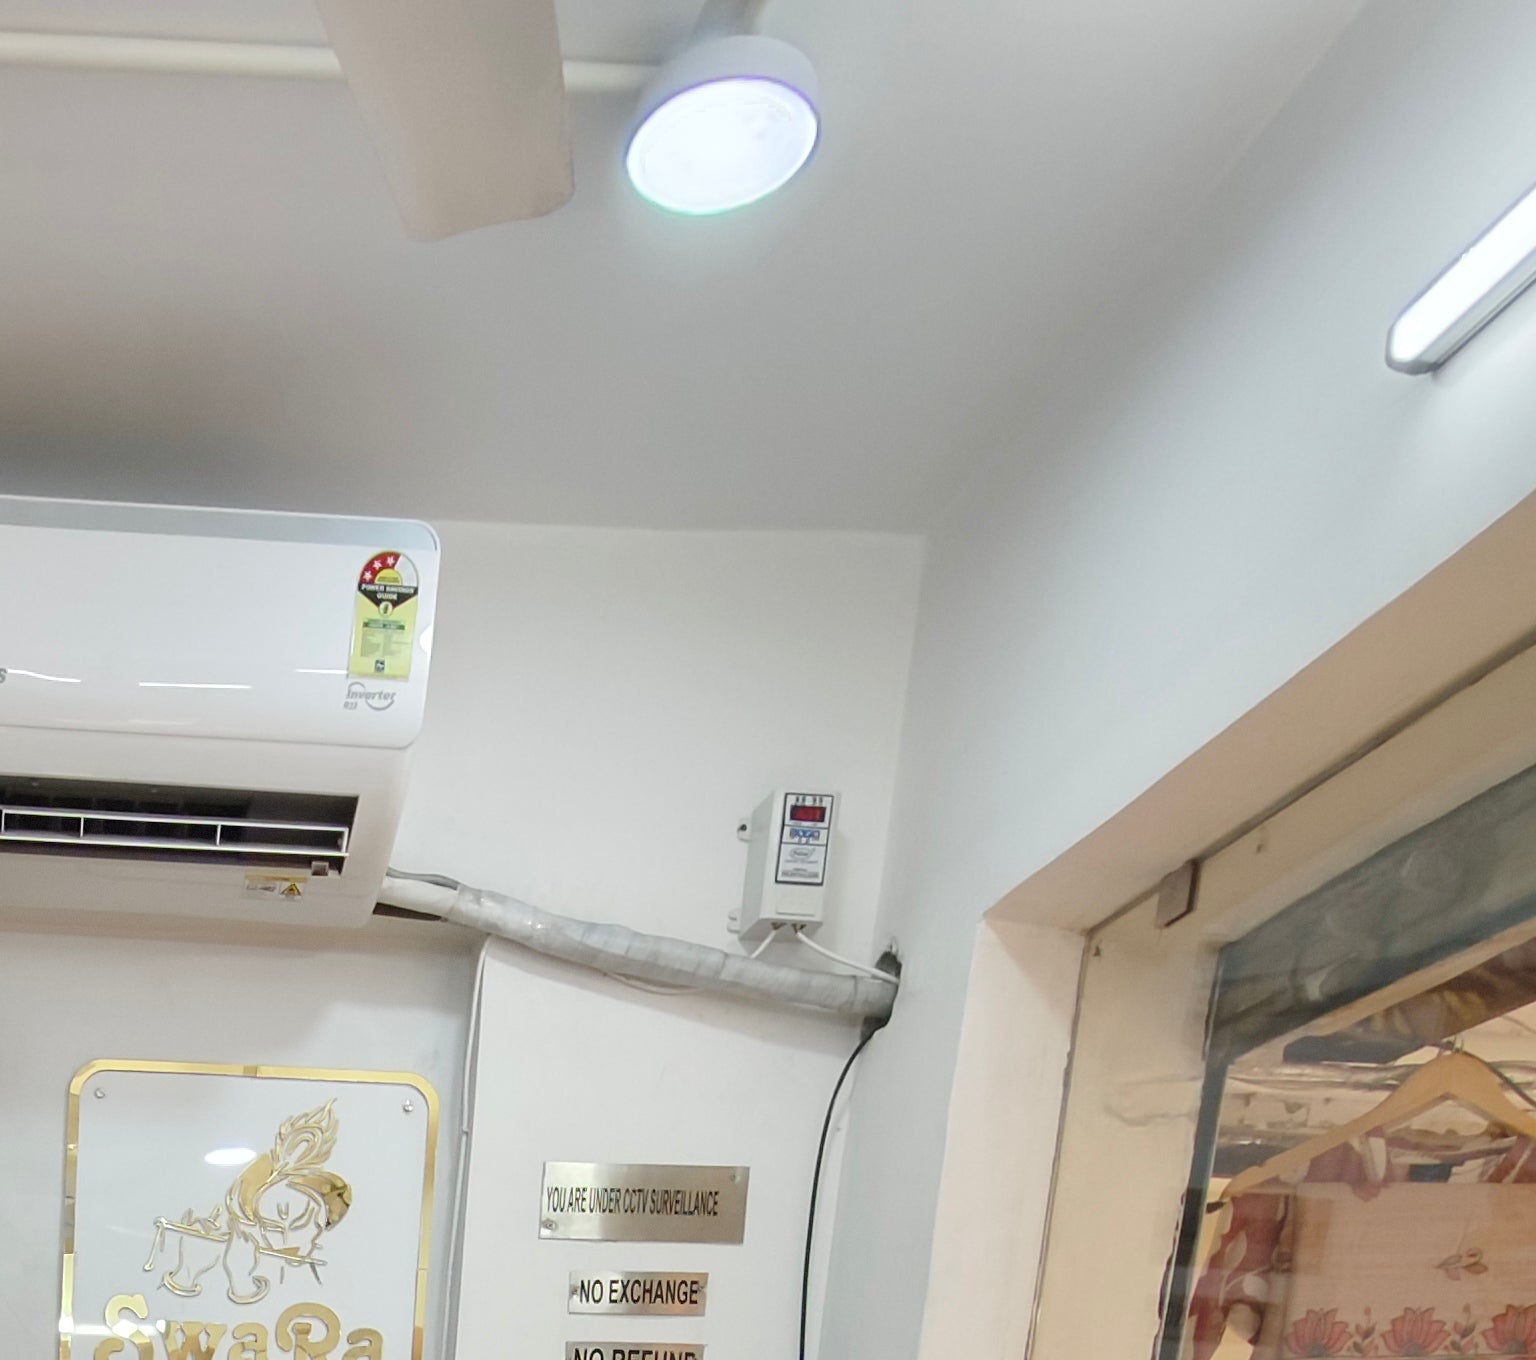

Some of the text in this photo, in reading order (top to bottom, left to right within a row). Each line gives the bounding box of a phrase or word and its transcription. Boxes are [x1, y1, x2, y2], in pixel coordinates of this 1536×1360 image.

[546, 1186, 720, 1217] YOU ARE UNDER CCTV SURVEILLANCE
[579, 1279, 700, 1305] NO EXCHANGE
